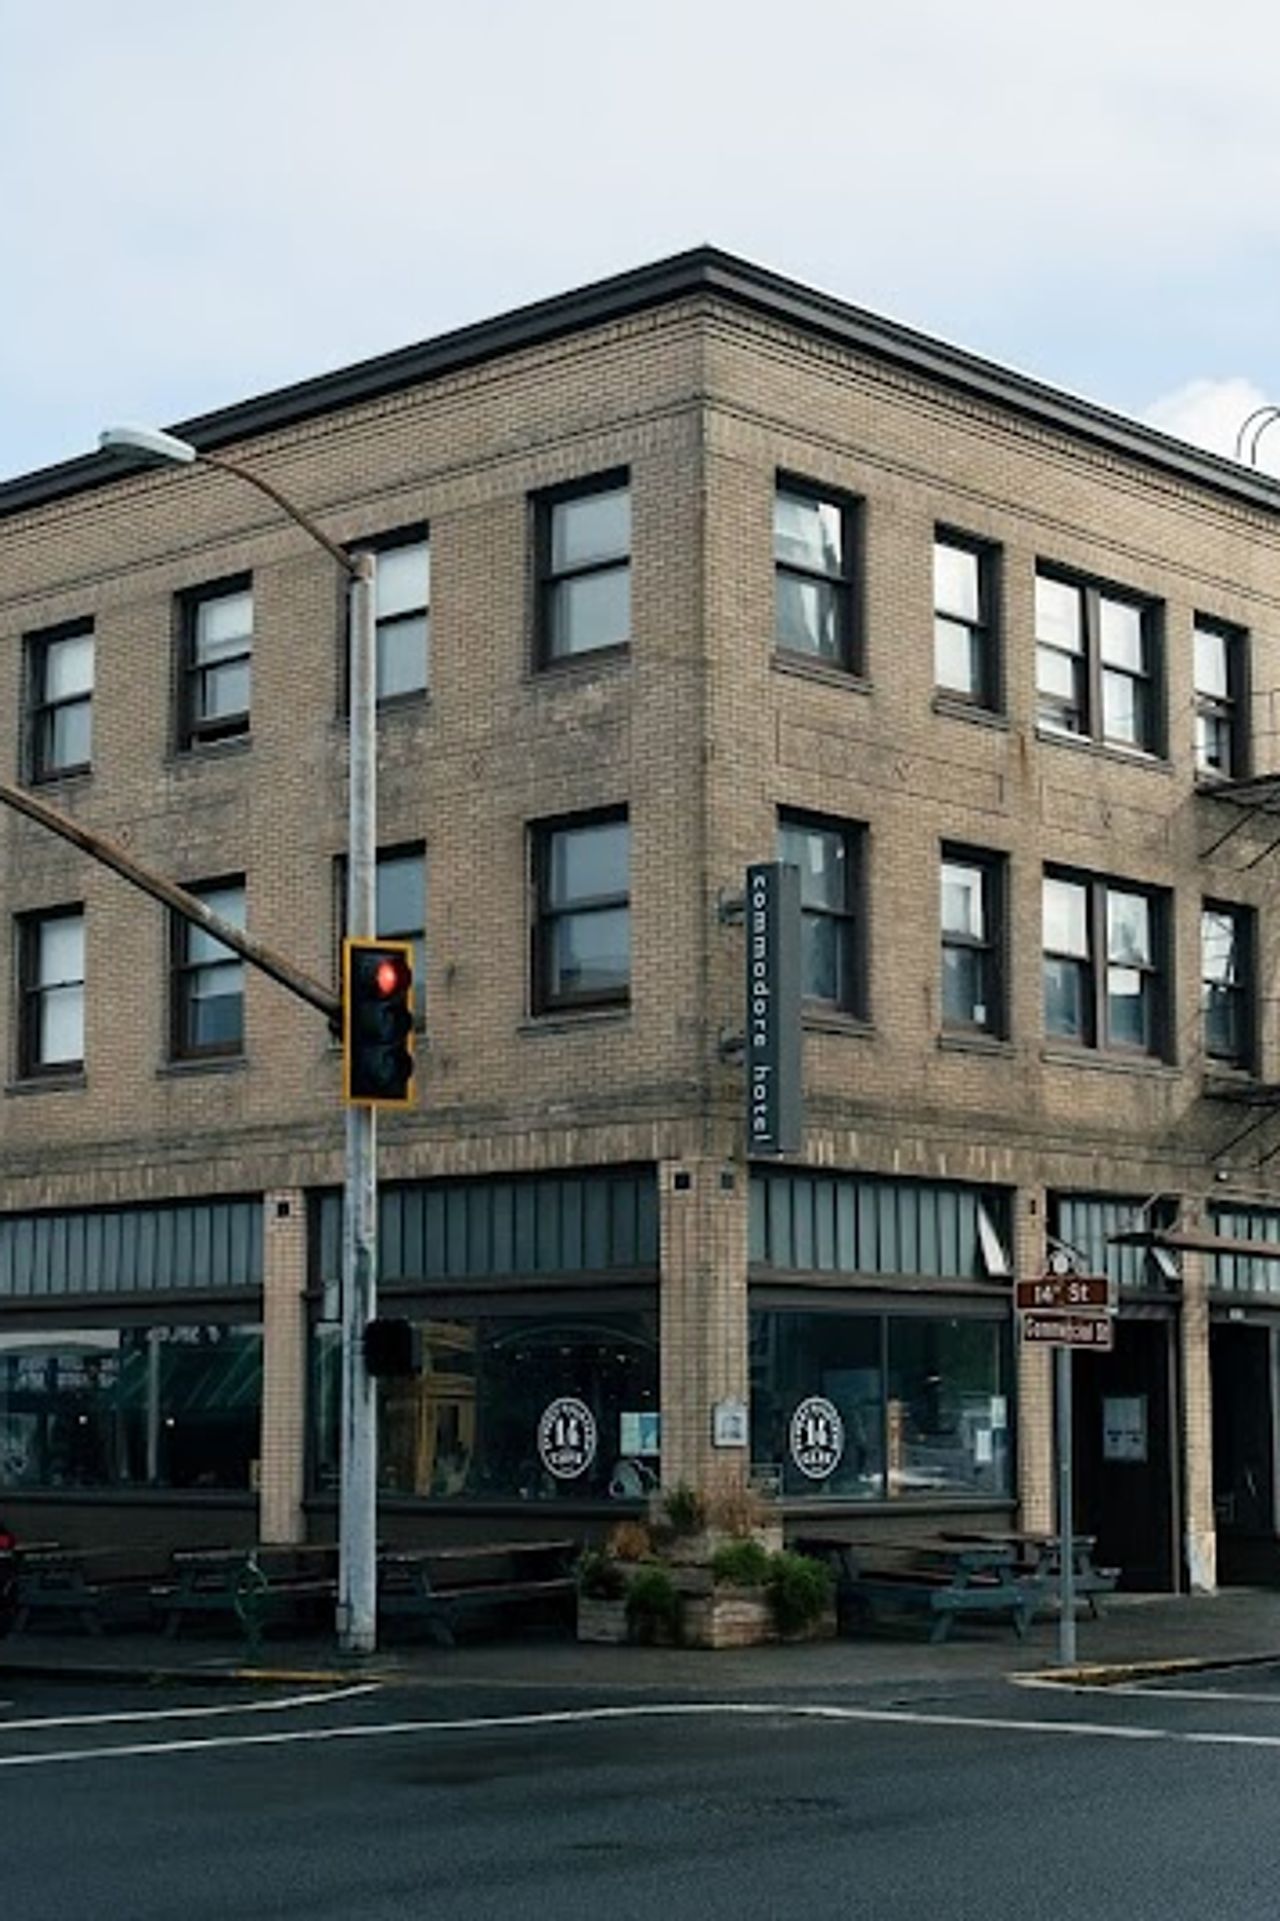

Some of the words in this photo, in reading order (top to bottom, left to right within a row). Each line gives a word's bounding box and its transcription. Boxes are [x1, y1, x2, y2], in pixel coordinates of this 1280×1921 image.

[753, 875, 770, 1046] commodore
[753, 1065, 771, 1140] hotel
[1069, 1282, 1089, 1302] St
